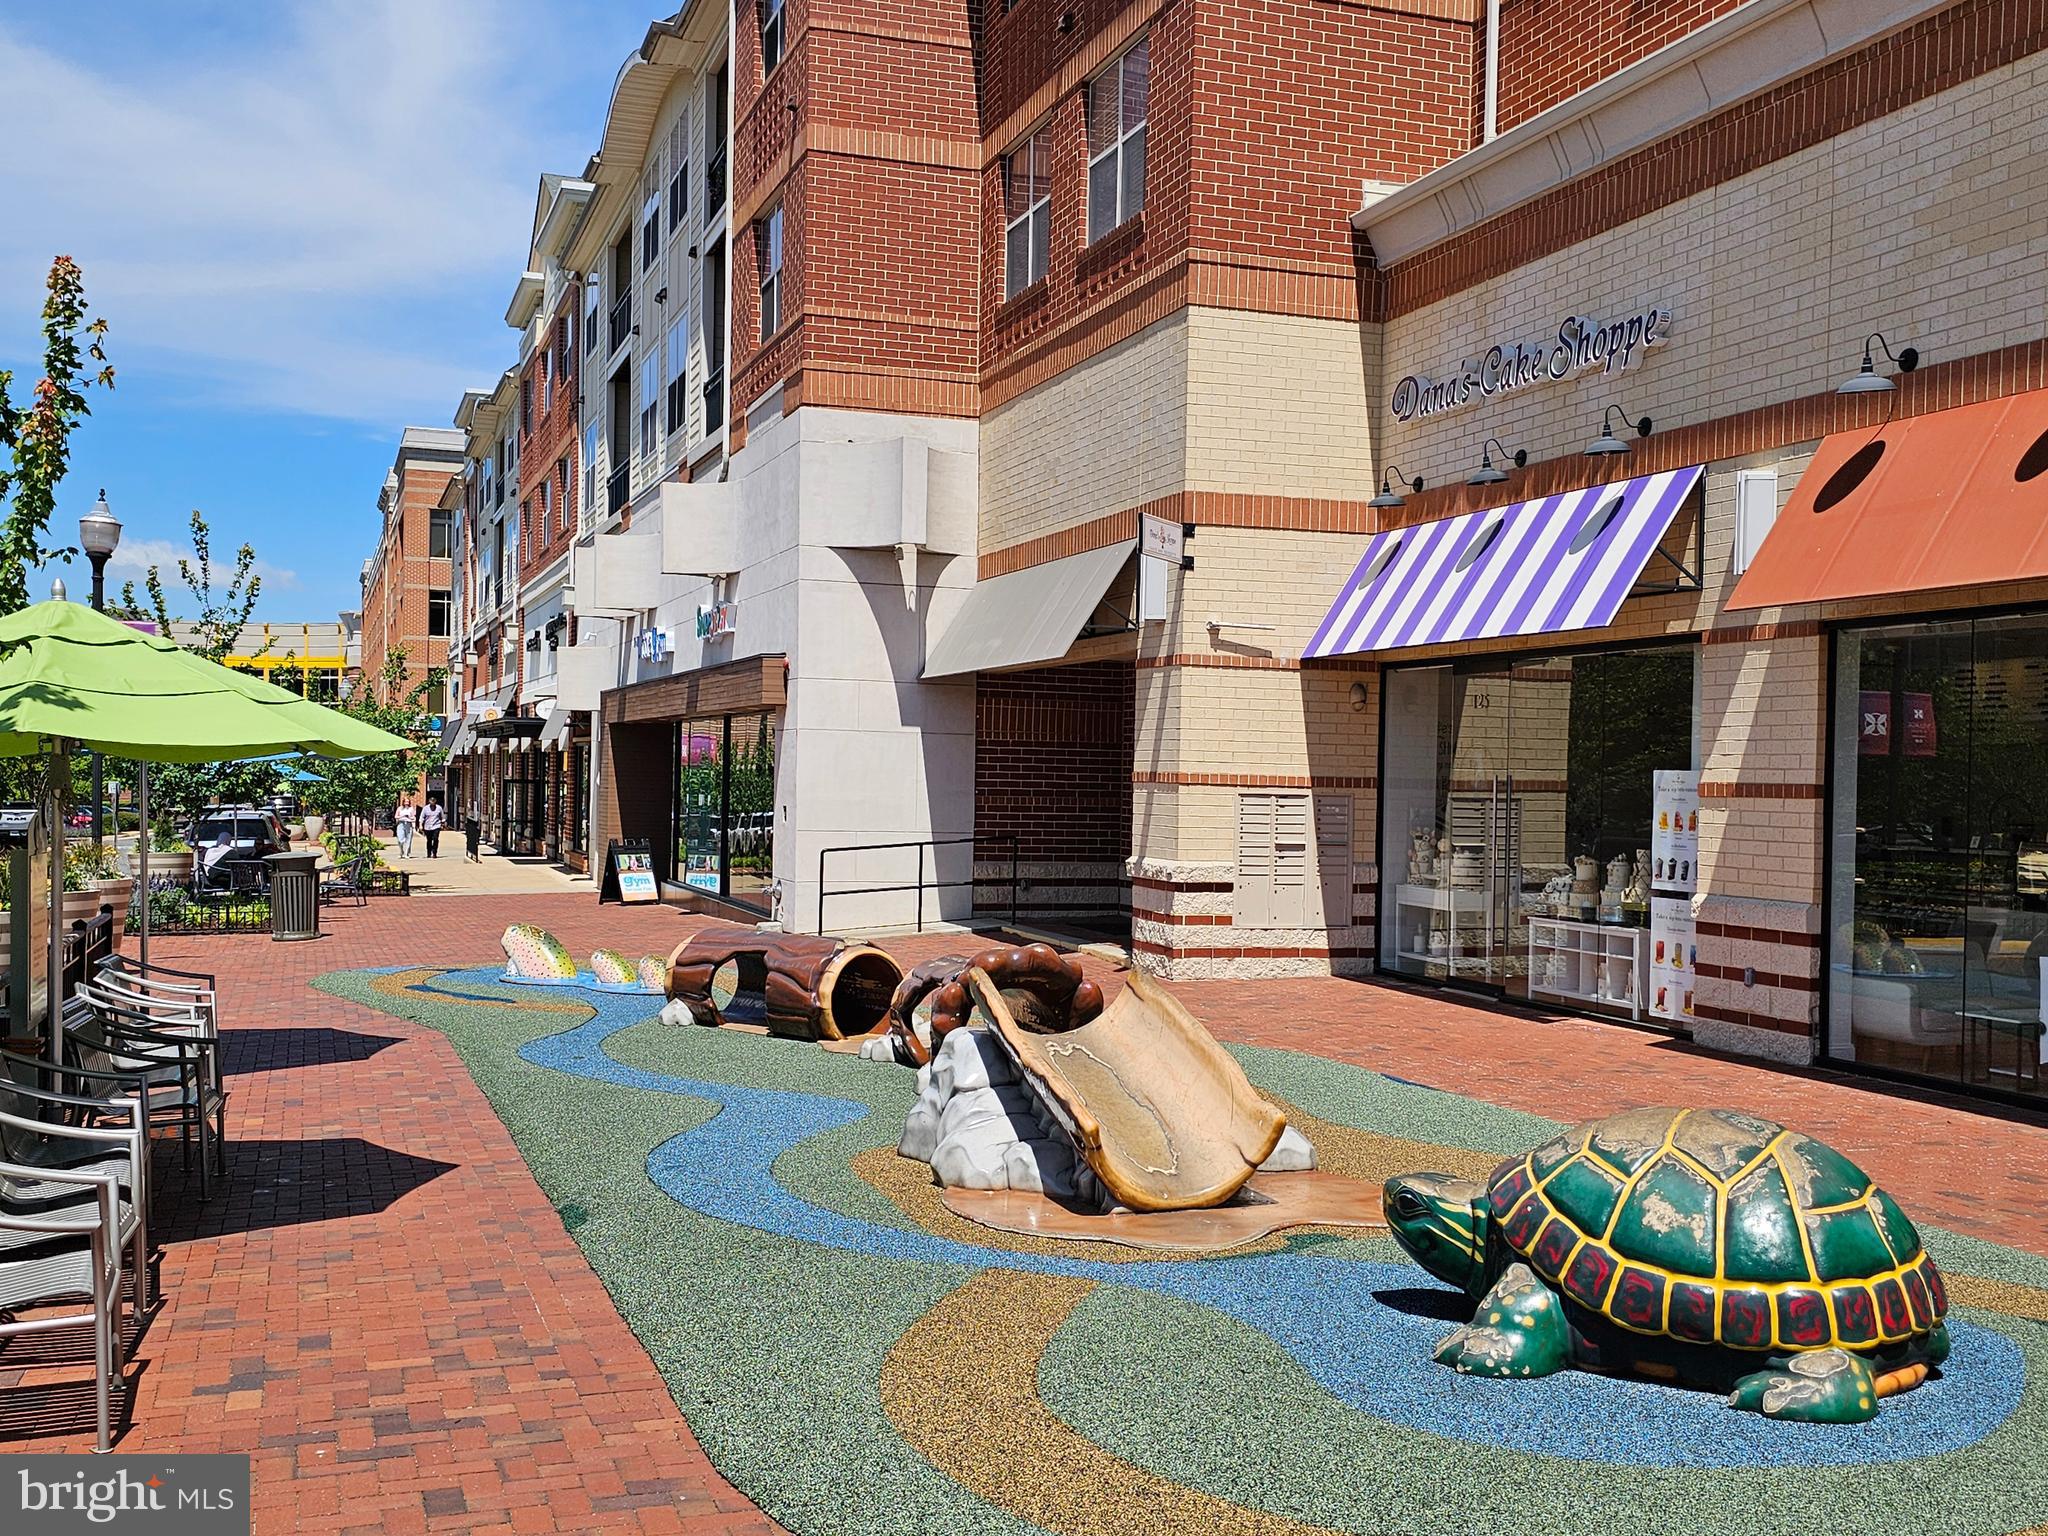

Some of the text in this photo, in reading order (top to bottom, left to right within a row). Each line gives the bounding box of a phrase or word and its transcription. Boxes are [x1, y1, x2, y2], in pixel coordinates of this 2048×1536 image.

[1392, 310, 1660, 422] Dana's Cake Shoppe
[1474, 694, 1490, 708] 125
[623, 875, 651, 888] gym
